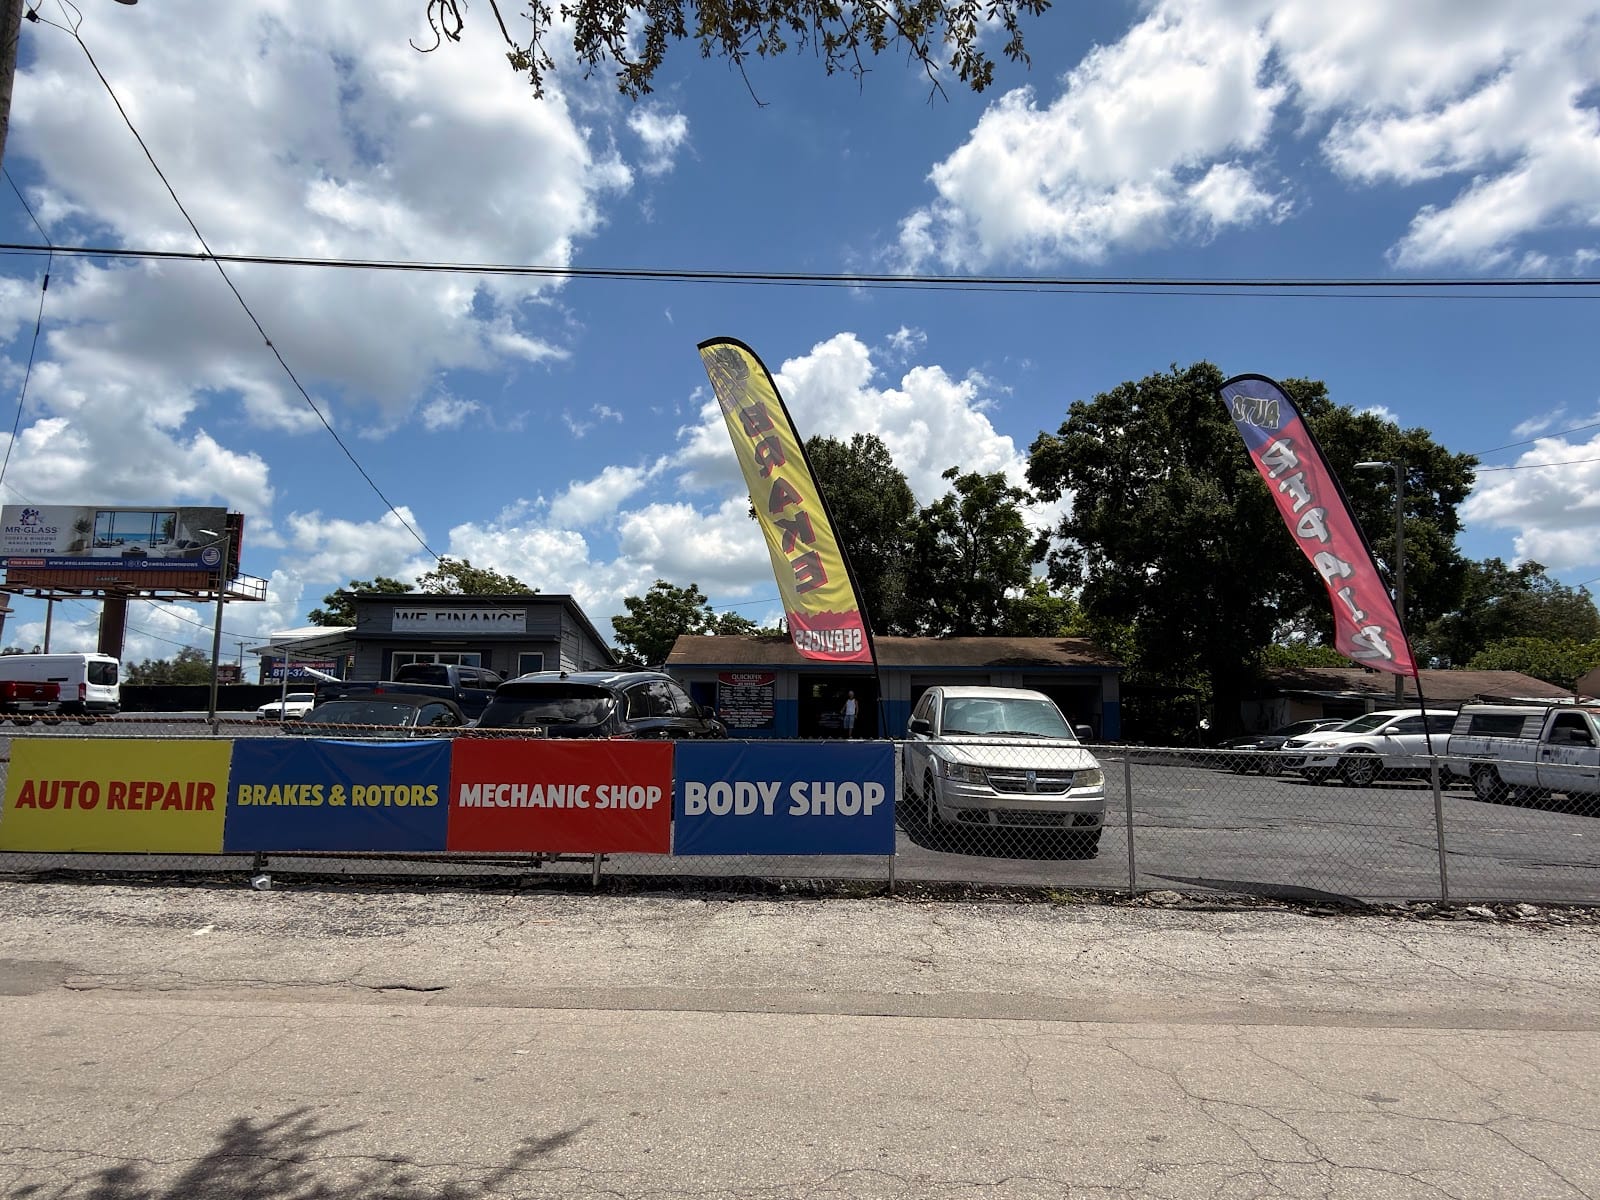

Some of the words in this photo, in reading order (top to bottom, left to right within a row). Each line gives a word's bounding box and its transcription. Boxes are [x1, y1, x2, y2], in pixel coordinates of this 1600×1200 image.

[15, 780, 100, 810] AUTO
[106, 780, 216, 811] REPAIR
[237, 784, 324, 807] BRAKES
[328, 784, 347, 807] &
[351, 785, 439, 807] ROTORS
[458, 783, 591, 809] MECHANIC
[594, 784, 662, 810] SHOP
[684, 781, 782, 816] BODY
[788, 781, 885, 816] SHOP
